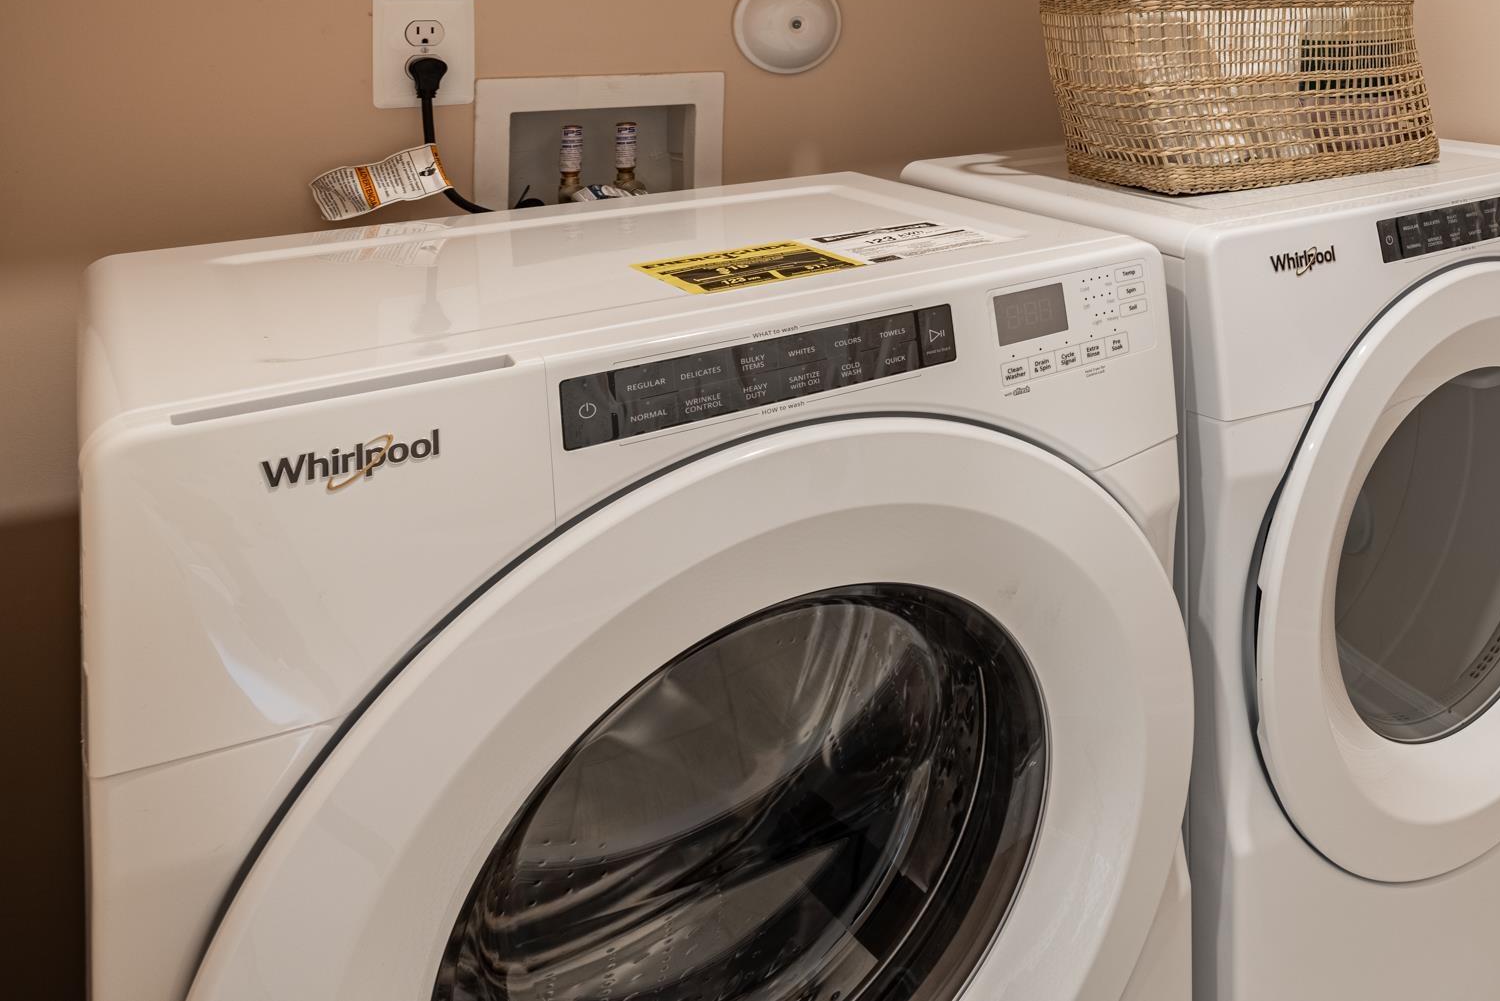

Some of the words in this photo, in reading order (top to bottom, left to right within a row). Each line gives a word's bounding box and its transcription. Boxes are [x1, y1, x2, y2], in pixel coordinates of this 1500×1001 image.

[1270, 245, 1336, 273] Whirlpool
[1122, 269, 1136, 277] Temp
[1126, 286, 1137, 295] Spin
[752, 329, 773, 339] WHAT
[781, 324, 799, 333] wash
[879, 327, 906, 339] TOWELS
[834, 336, 862, 348] COLORS
[788, 345, 816, 357] WHITES
[1086, 344, 1100, 353] Extra
[740, 353, 765, 366] BULKY
[1061, 350, 1075, 360] Cycle
[1086, 350, 1100, 359] Rinse
[841, 361, 861, 371] COLD
[884, 355, 906, 366] QUICK
[1034, 358, 1050, 367] Drain
[1060, 357, 1077, 366] Signal
[742, 361, 765, 372] ITEMS
[1007, 365, 1023, 374] Clean
[1039, 364, 1052, 373] Spin
[680, 365, 722, 381] DELICATES
[788, 370, 820, 384] SANITIZE
[841, 368, 862, 378] WASH
[1005, 371, 1026, 381] Washer
[626, 377, 667, 392] REGULAR
[743, 382, 768, 393] HEAVY
[790, 380, 807, 391] with
[807, 377, 820, 387] OXI
[685, 392, 721, 407] WRINKLE
[745, 390, 767, 400] DUTY
[685, 400, 723, 415] CONTROL
[761, 406, 778, 416] HOW
[779, 404, 786, 412] to
[787, 400, 805, 410] wash
[630, 408, 668, 423] NORMAL
[261, 429, 440, 488] Whirlpool
